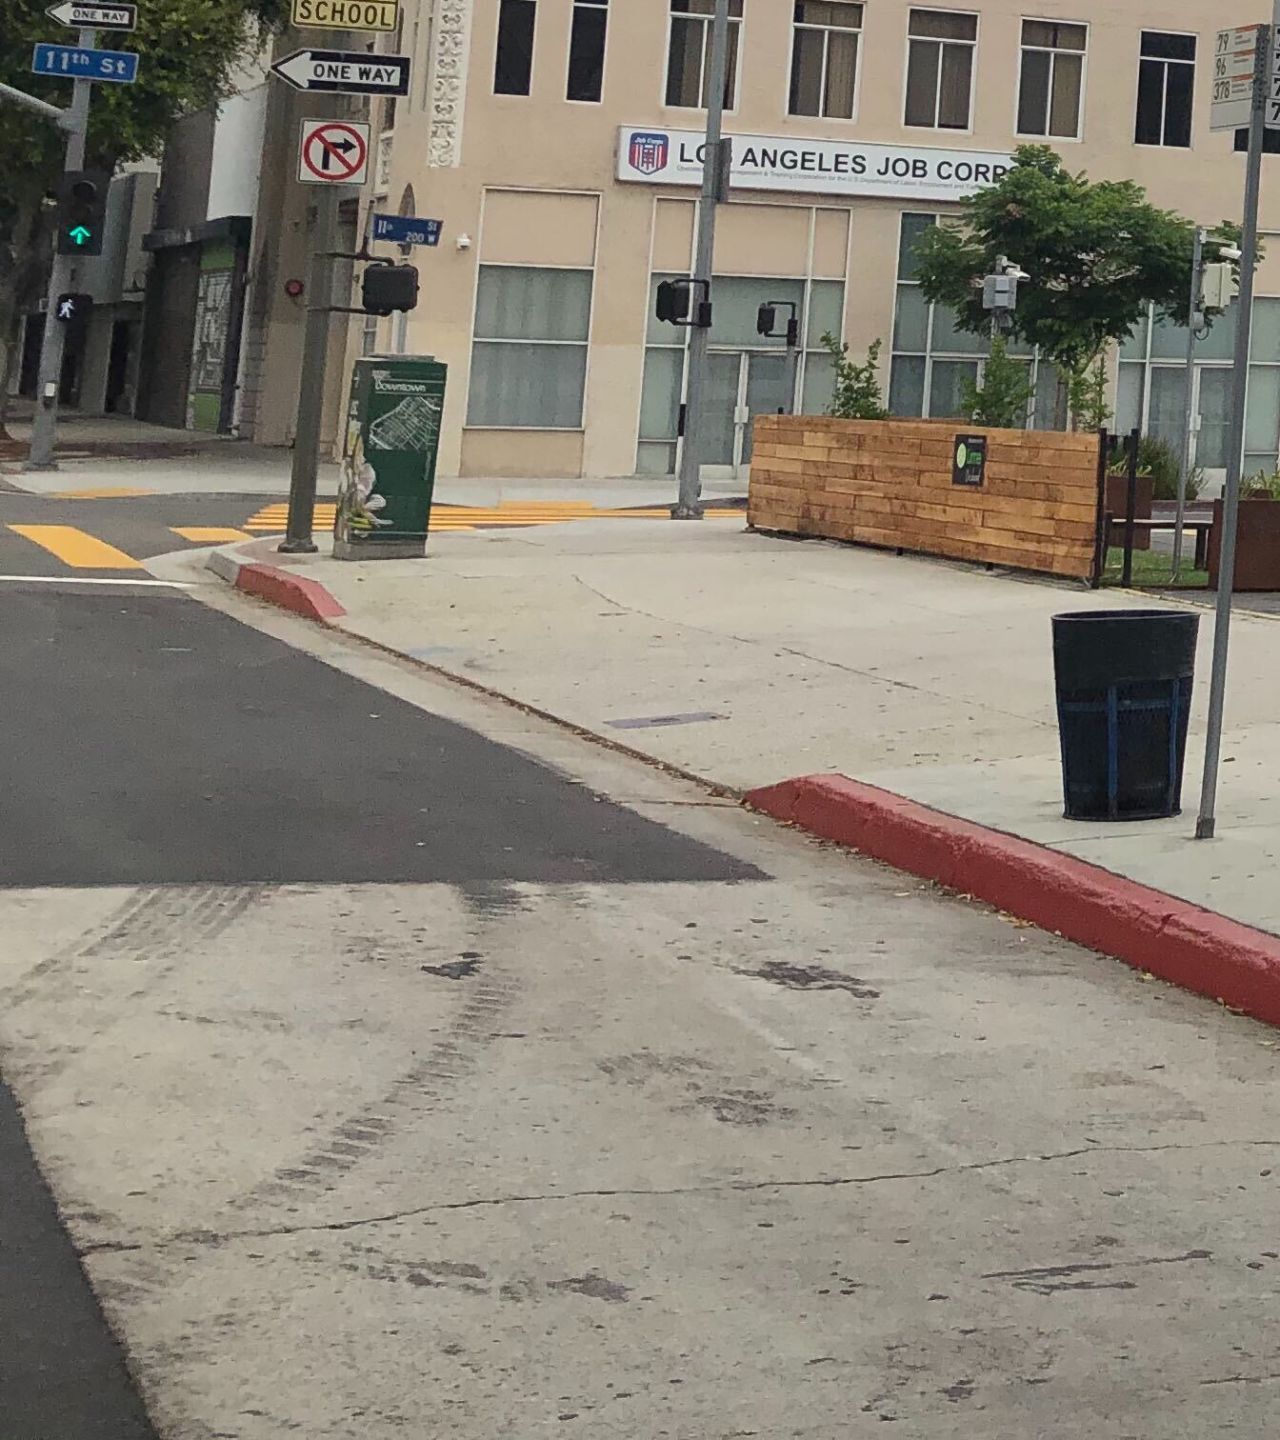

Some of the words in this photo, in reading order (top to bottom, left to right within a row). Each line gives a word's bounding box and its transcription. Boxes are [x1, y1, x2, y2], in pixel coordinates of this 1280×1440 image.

[73, 9, 96, 20] ONE
[102, 11, 126, 21] WAY
[300, 0, 392, 26] SCHOOL
[1218, 33, 1229, 52] 79
[46, 51, 90, 70] 11th
[100, 58, 126, 74] St
[1216, 58, 1226, 76] 96
[314, 64, 351, 79] ONE
[358, 66, 395, 82] WAY
[1214, 81, 1230, 100] 378
[740, 148, 866, 174] ANGELES
[877, 157, 928, 178] JOB
